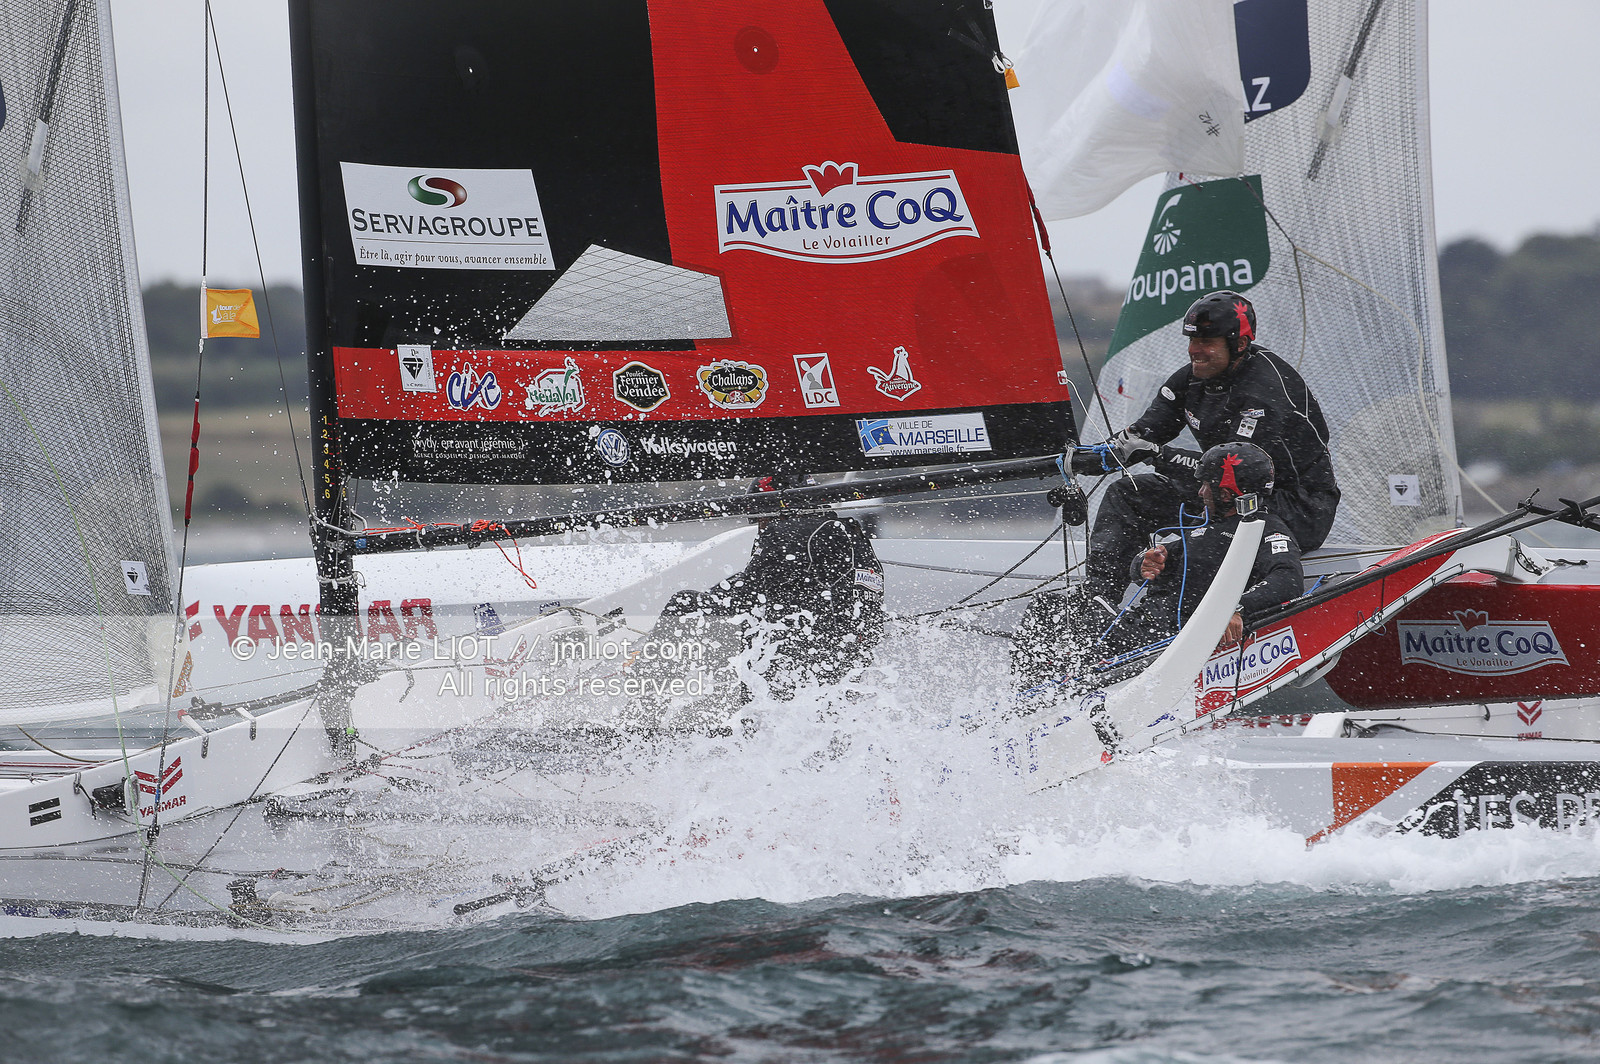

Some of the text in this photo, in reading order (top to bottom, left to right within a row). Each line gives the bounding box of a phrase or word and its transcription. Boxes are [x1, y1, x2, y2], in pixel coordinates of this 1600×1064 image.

[351, 208, 543, 237] SERVAGROUPE
[726, 186, 965, 240] Maître CoQ
[802, 234, 892, 251] Le Volailler
[359, 246, 548, 266] Être là, agir pour vous, avancer ensemble
[1121, 258, 1254, 308] roupama
[620, 374, 659, 386] Fermier
[711, 373, 754, 387] Challans
[618, 383, 666, 398] Vendée
[897, 420, 933, 430] VILLE DE
[640, 437, 738, 458] Volkswagen
[899, 428, 985, 447] MARSEILLE
[212, 597, 439, 648] YANAR
[1260, 636, 1296, 665] CoQ
[1404, 629, 1559, 656] Maître CoQ
[1456, 657, 1514, 667] Le Volailler
